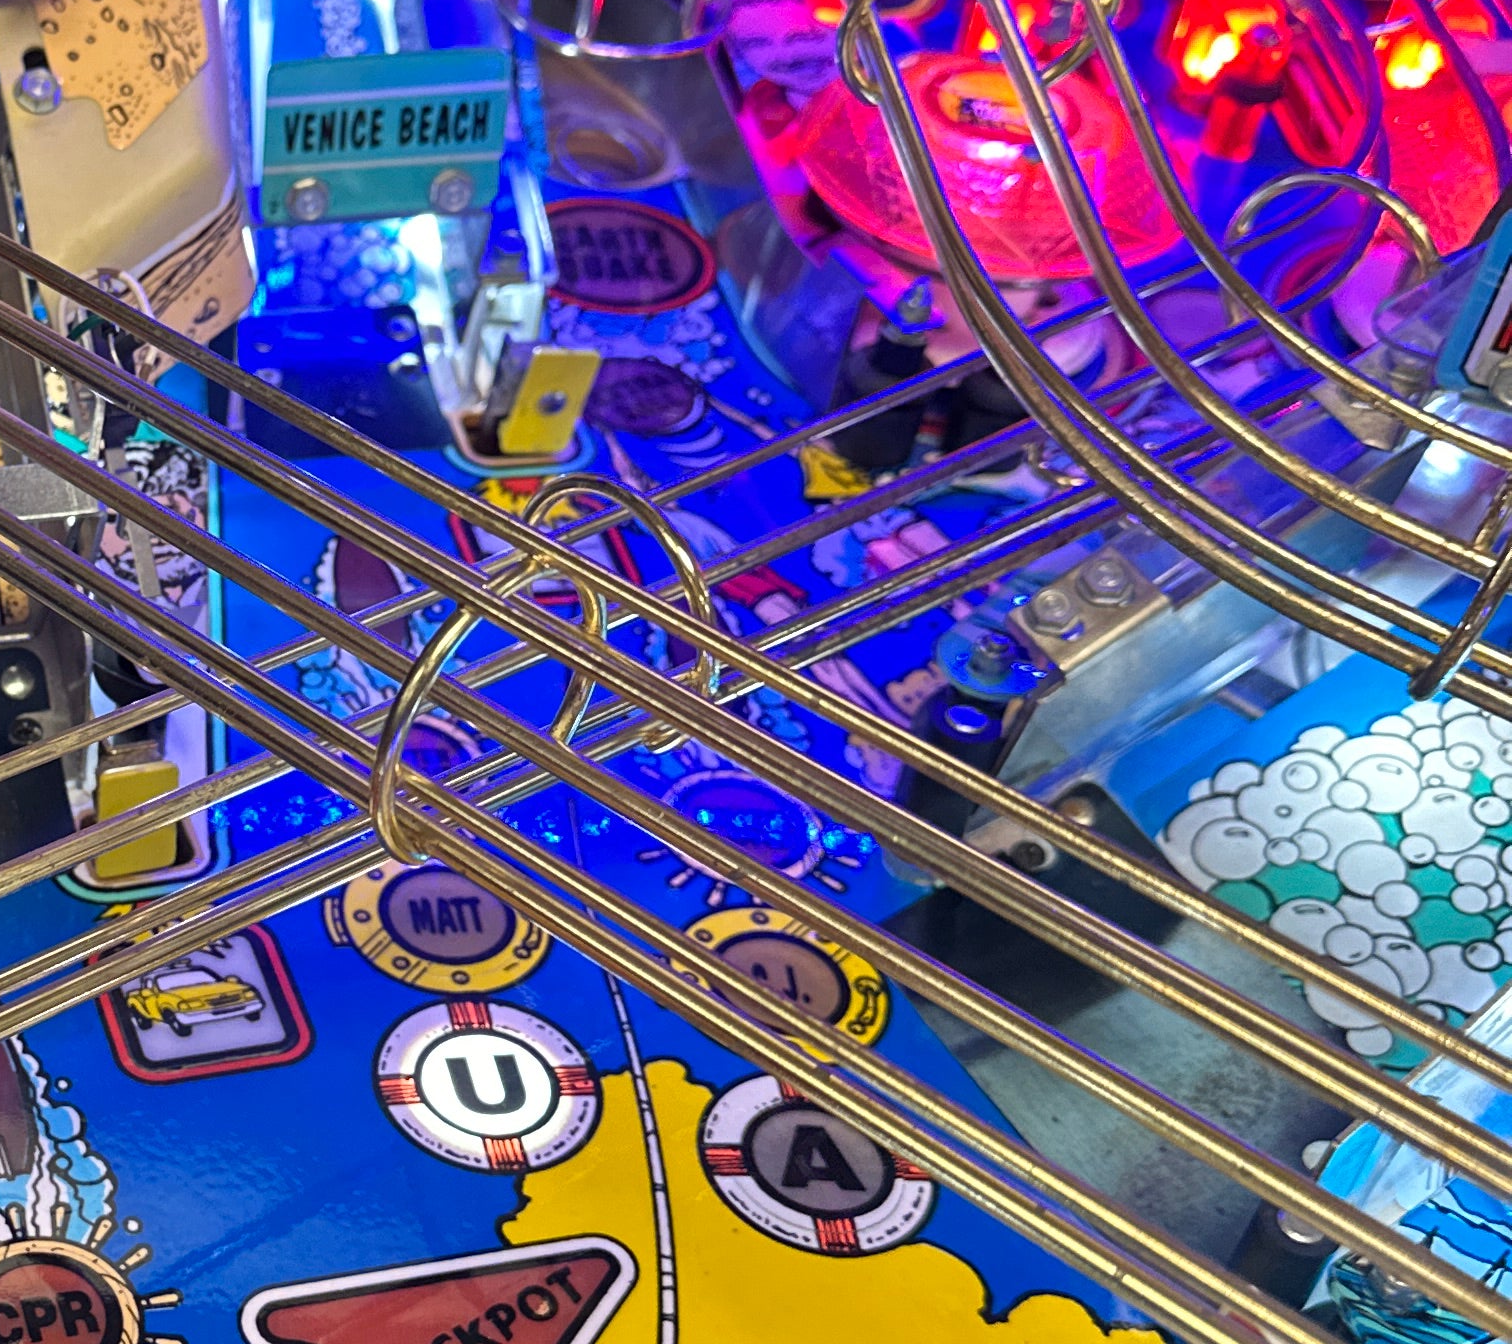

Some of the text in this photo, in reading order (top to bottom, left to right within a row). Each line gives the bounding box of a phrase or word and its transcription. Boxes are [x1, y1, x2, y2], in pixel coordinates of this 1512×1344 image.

[284, 100, 491, 153] VENICE BEACH
[407, 893, 484, 936] MATT
[445, 1052, 528, 1116] U
[781, 1123, 867, 1193] A
